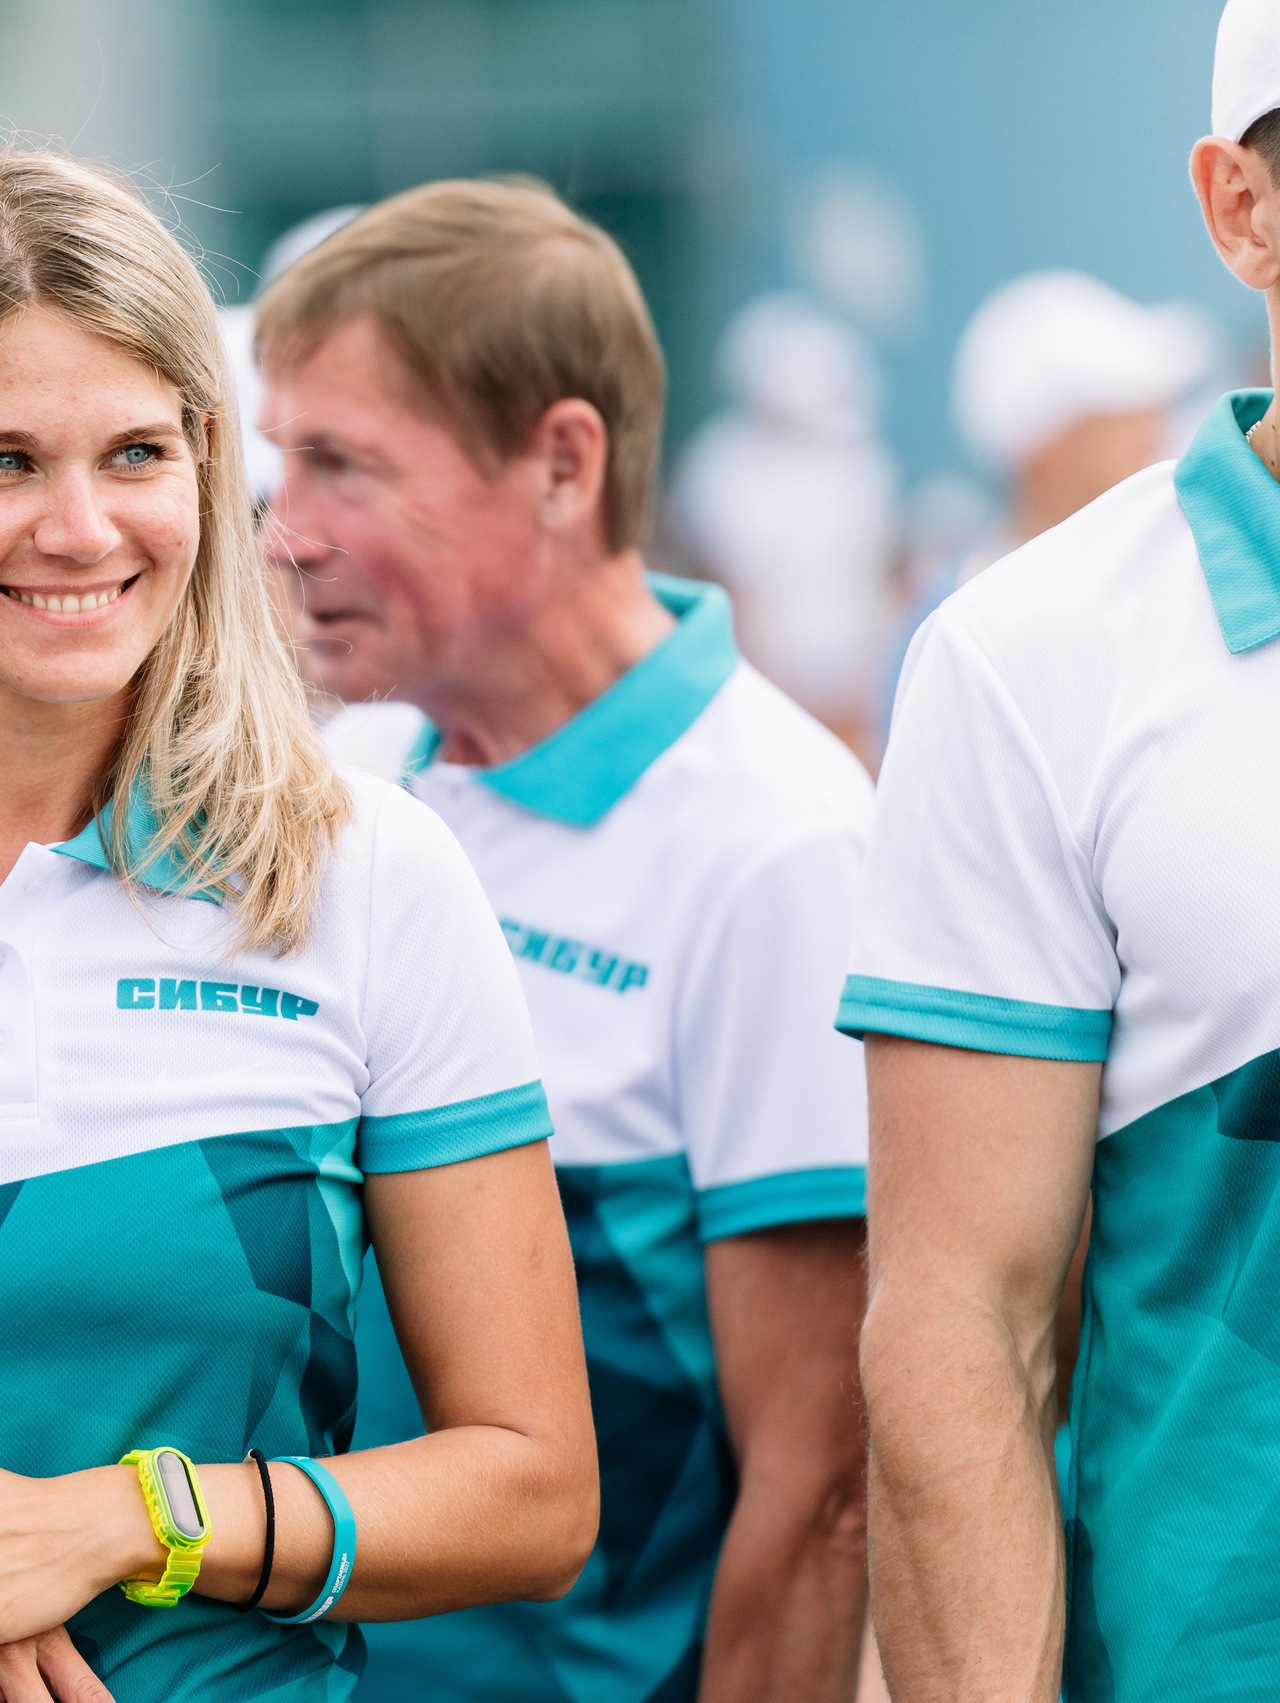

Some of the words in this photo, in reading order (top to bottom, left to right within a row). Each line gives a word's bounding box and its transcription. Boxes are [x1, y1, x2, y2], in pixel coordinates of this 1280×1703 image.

[116, 977, 320, 1020] СИБУР
[332, 1553, 347, 1593] СПАРТАКИАДА
[299, 1596, 334, 1623] БУР
